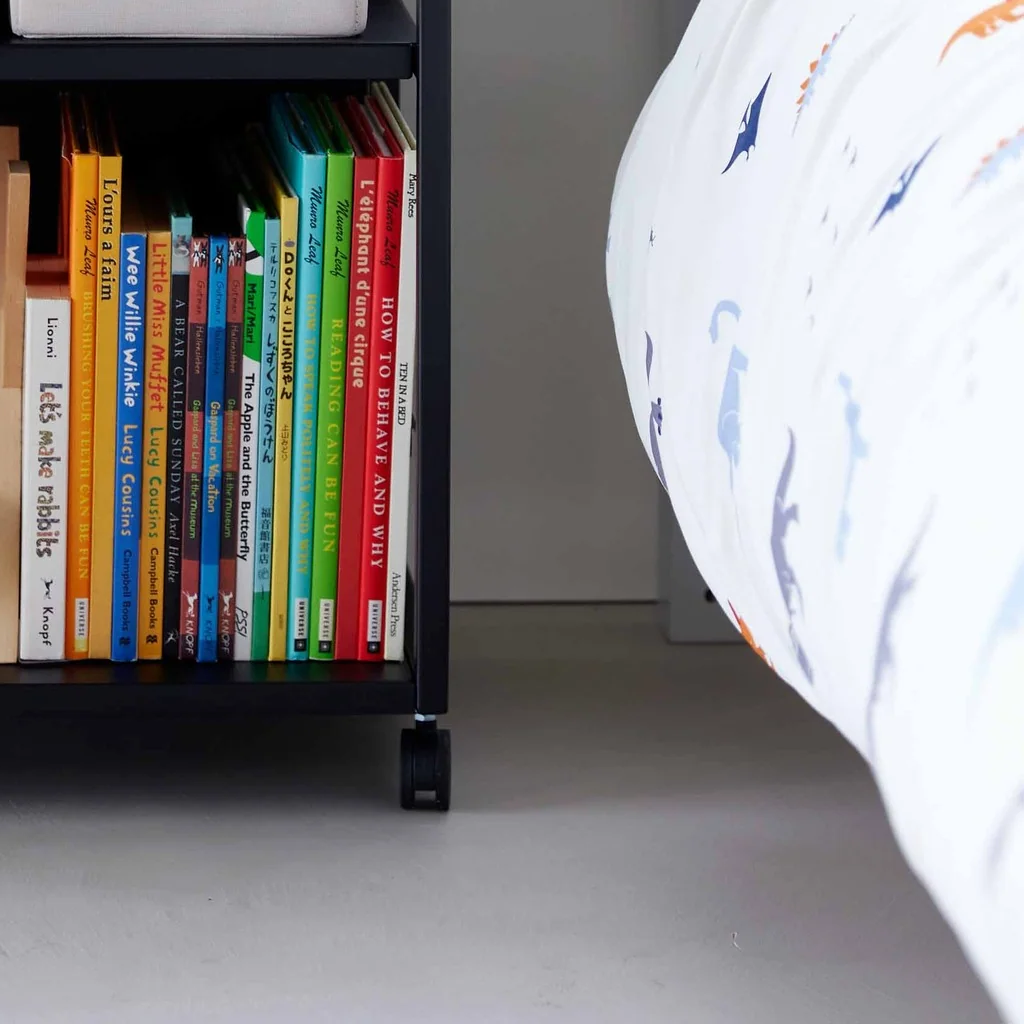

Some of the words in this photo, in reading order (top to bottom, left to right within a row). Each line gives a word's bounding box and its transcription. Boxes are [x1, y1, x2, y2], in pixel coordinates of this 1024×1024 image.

[407, 173, 417, 196] Mary
[84, 198, 97, 240] Munro
[102, 178, 118, 235] L'ours
[309, 186, 323, 229] Munro
[335, 199, 349, 242] Munro
[356, 180, 374, 274] L'éléphant
[386, 189, 399, 232] Munro
[408, 198, 417, 218] Rees
[79, 245, 96, 277] Leaf
[102, 241, 113, 251] a
[126, 245, 140, 286] Wee
[304, 233, 321, 265] Leaf
[330, 246, 347, 278] Leaf
[101, 258, 116, 301] faim
[152, 243, 168, 293] Little
[124, 291, 142, 342] Willie
[152, 299, 167, 338] Miss
[175, 299, 186, 309] A
[307, 293, 317, 331] HOW
[355, 280, 371, 328] d'une
[380, 297, 394, 342] HOW
[46, 317, 58, 358] Lionni
[81, 291, 93, 372] BRUSHING
[174, 318, 185, 357] BEAR
[304, 339, 315, 360] TO
[123, 348, 140, 407] Winkie
[148, 344, 168, 412] Muffet
[328, 319, 344, 412] READING
[350, 334, 368, 388] cirque
[379, 351, 392, 378] TO
[399, 362, 408, 383] TEN
[39, 382, 63, 424] Let's
[81, 378, 92, 422] YOUR
[172, 366, 184, 430] CALLED
[244, 373, 255, 399] The
[303, 362, 314, 413] SPEAK
[398, 384, 407, 396] IN
[398, 396, 406, 405] A
[209, 401, 221, 444] Gaspard
[240, 403, 254, 443] Apple
[375, 387, 390, 465] BEHAVE
[397, 406, 406, 426] BED
[38, 430, 61, 478] make
[80, 431, 91, 478] TEETH
[120, 424, 138, 465] Lucy
[147, 427, 164, 467] Lucy
[208, 446, 217, 461] on
[242, 446, 252, 470] and
[300, 419, 313, 493] POLITELY
[327, 423, 339, 465] CAN
[169, 438, 182, 504] SUNDAY
[207, 463, 220, 513] Vacation
[241, 474, 252, 497] the
[325, 477, 337, 501] BE
[79, 484, 90, 517] CAN
[121, 473, 136, 537] Cousins
[148, 476, 162, 538] Cousins
[373, 473, 386, 516] AND
[36, 485, 60, 558] rabbits
[79, 523, 89, 541] BE
[169, 512, 180, 541] Axel
[189, 498, 198, 539] museum
[236, 501, 251, 562] Butterfly
[299, 499, 310, 534] AND
[322, 511, 336, 553] FUN
[78, 548, 88, 580] FUN
[167, 545, 179, 583] Hacke
[296, 539, 309, 575] WHY
[371, 524, 385, 568] WHY
[120, 549, 132, 598] Campbell
[148, 547, 159, 596] Campbell
[390, 572, 401, 613] Andersen
[39, 607, 54, 646] Knopf
[120, 601, 131, 632] Books
[149, 599, 158, 629] Books
[322, 602, 330, 638] UNIVERSE
[390, 614, 400, 637] Press
[185, 620, 194, 654] KNOPF
[221, 619, 230, 653] KNOPF
